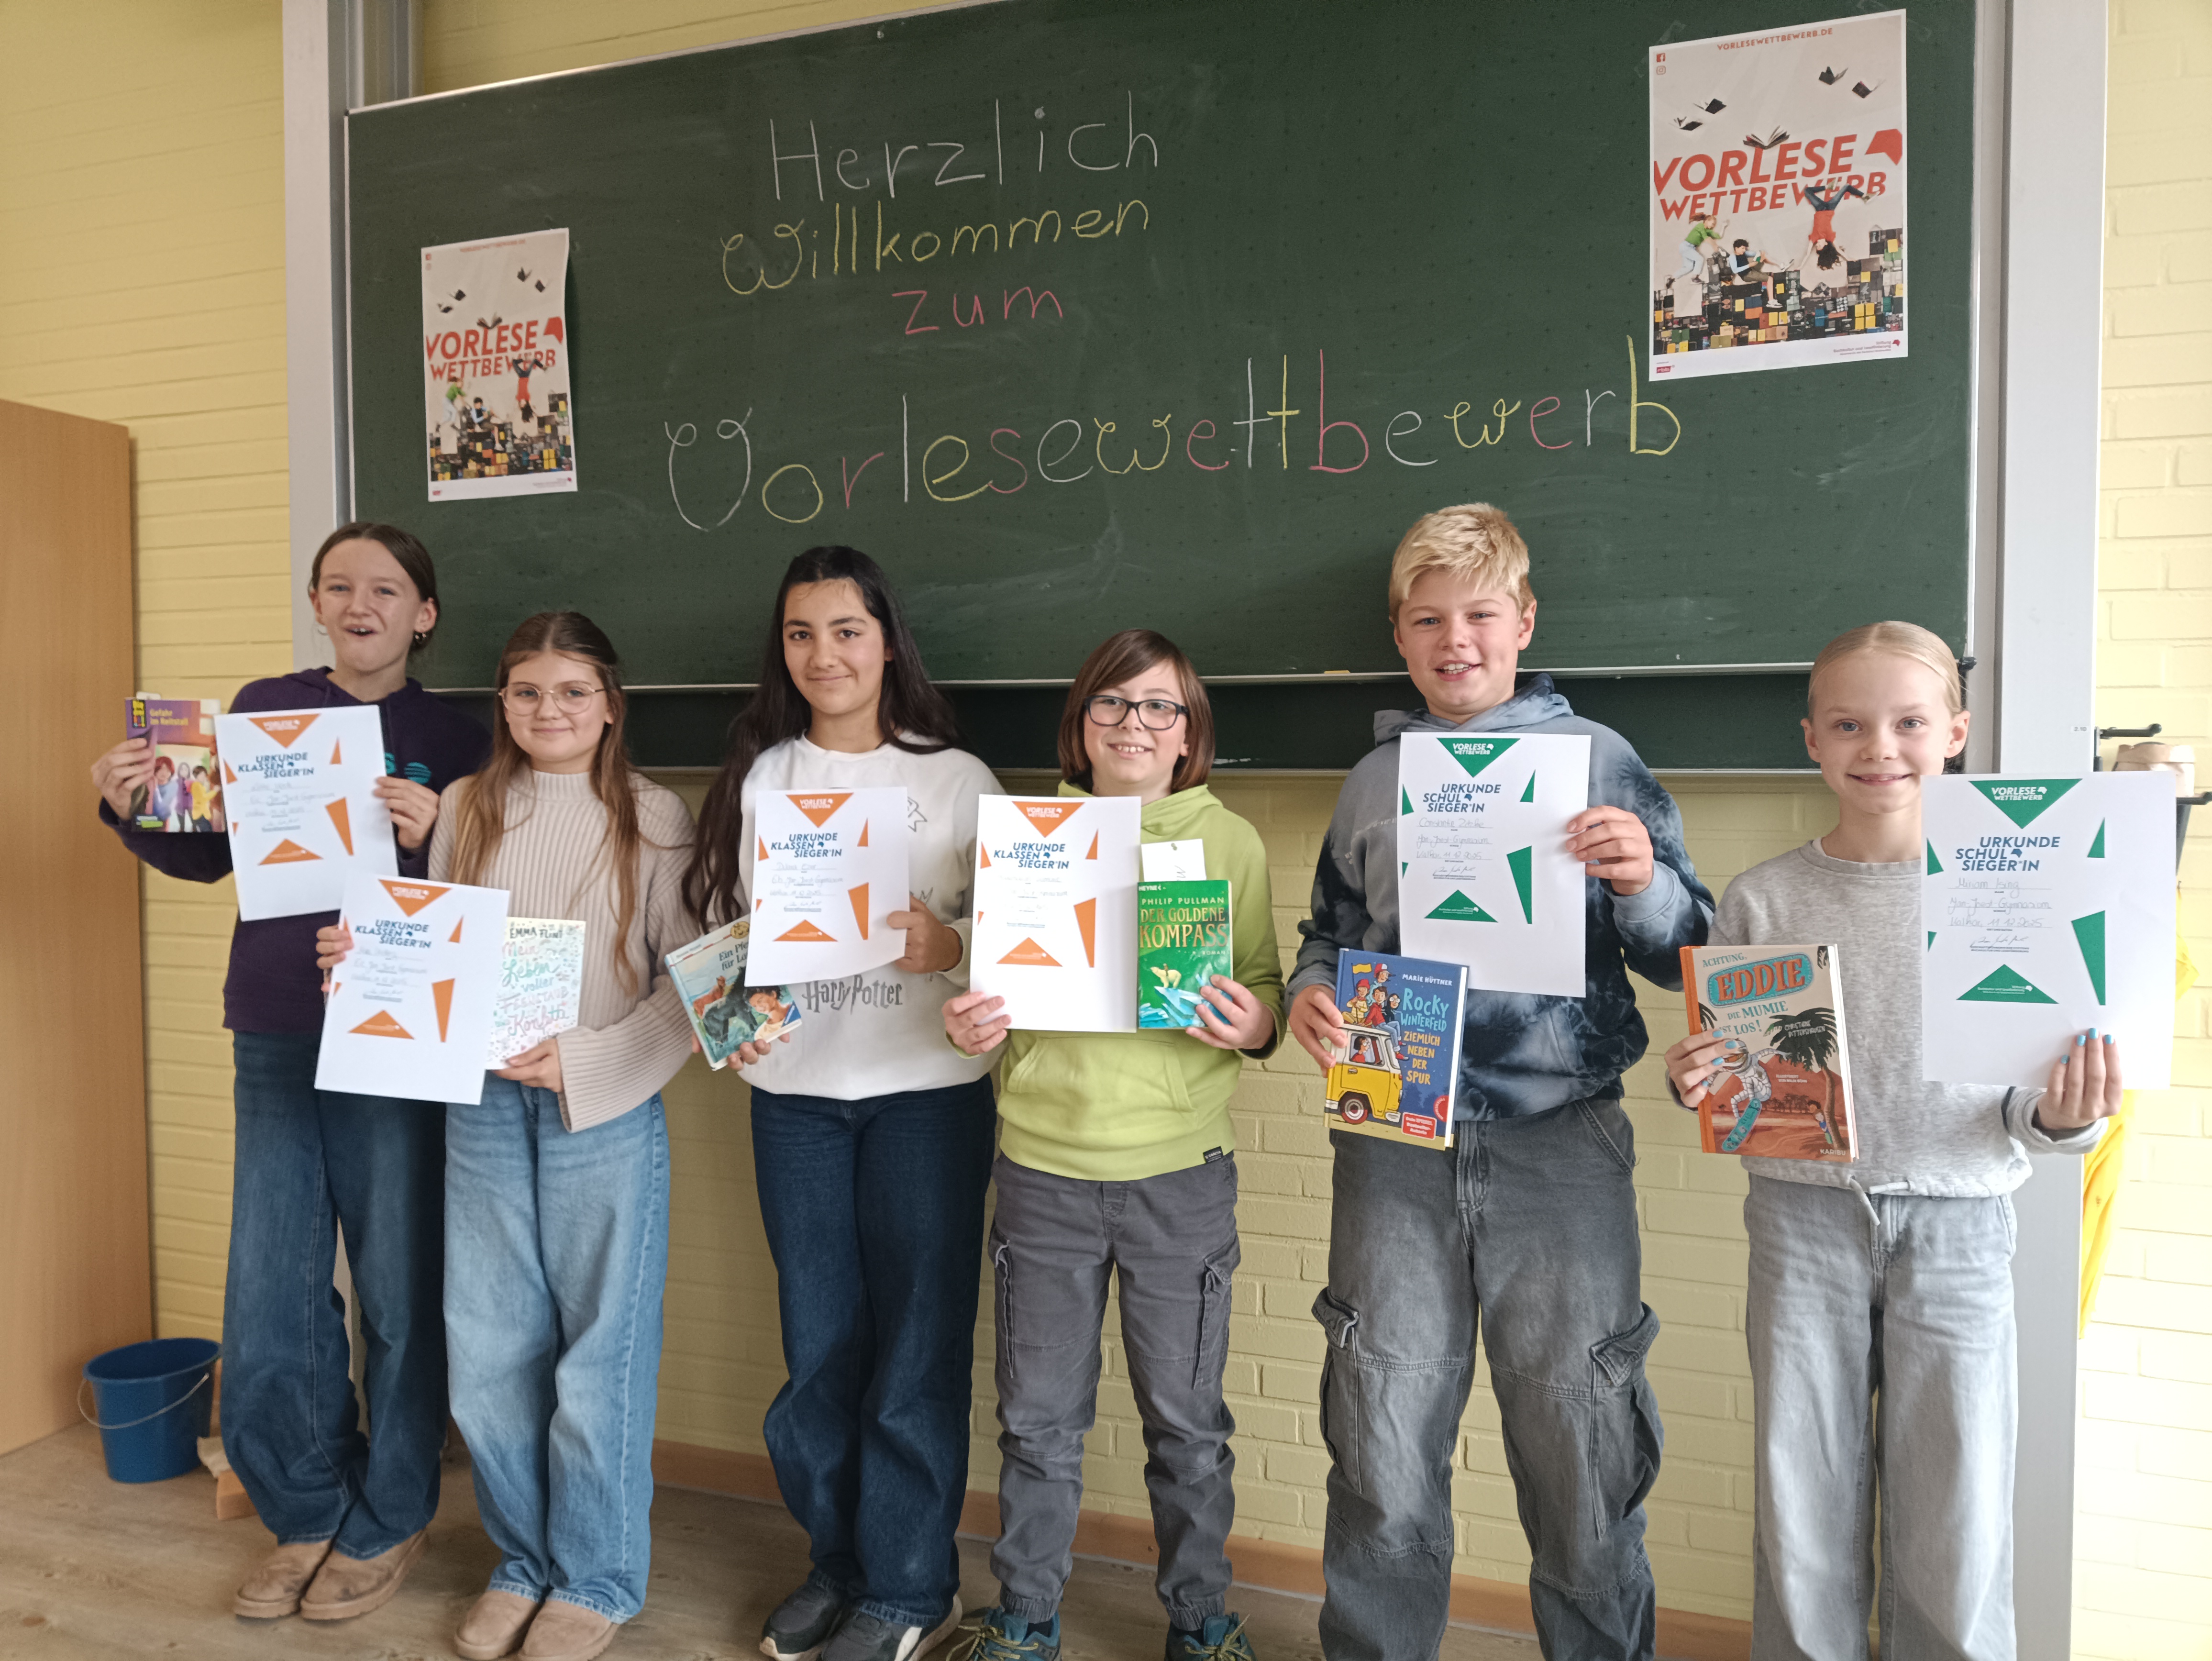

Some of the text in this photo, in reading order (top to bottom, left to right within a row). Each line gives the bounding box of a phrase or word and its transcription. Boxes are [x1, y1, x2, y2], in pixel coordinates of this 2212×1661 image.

[1717, 27, 1833, 51] VORLESEWETTBEWERB.DE
[769, 90, 1157, 201] Herzlich
[1654, 133, 1858, 196] VORLESE
[719, 199, 1149, 295] Willkommen
[426, 320, 539, 361] VORLESE
[664, 334, 1681, 532] Vorlesewettbewerb
[255, 752, 309, 764] URKUNDE
[238, 761, 285, 773] KLASSEN
[1441, 783, 1502, 794] URKUNDE
[1991, 786, 2037, 795] VORLESE
[1423, 793, 1461, 803] SCHUL
[788, 832, 838, 842] URKUNDE
[1980, 836, 2061, 848] URKUNDE
[771, 842, 815, 850] KLASSEN
[1013, 842, 1066, 853] URKUNDE
[994, 850, 1040, 860] KLASSEN
[1955, 848, 2008, 860] SCHUL
[1178, 897, 1225, 905] PULLMAN
[1140, 907, 1226, 923] DER GOLDENE
[354, 925, 403, 937] KLASSEN
[375, 919, 430, 932] URKUNDE
[509, 927, 563, 939] EMMA FLINT
[1139, 923, 1228, 948] KOMPASS
[719, 950, 733, 961] Ein
[1425, 975, 1453, 986] HÜTTNER
[1715, 958, 1806, 1001] EDDIE
[801, 974, 903, 1015] Harry Potter
[1727, 1000, 1789, 1020] DIE MUMIE
[1400, 1012, 1447, 1032] WINTERFELD
[1407, 1045, 1435, 1059] NEBEN
[1412, 1058, 1428, 1070] DER
[1406, 1070, 1431, 1085] SPUR
